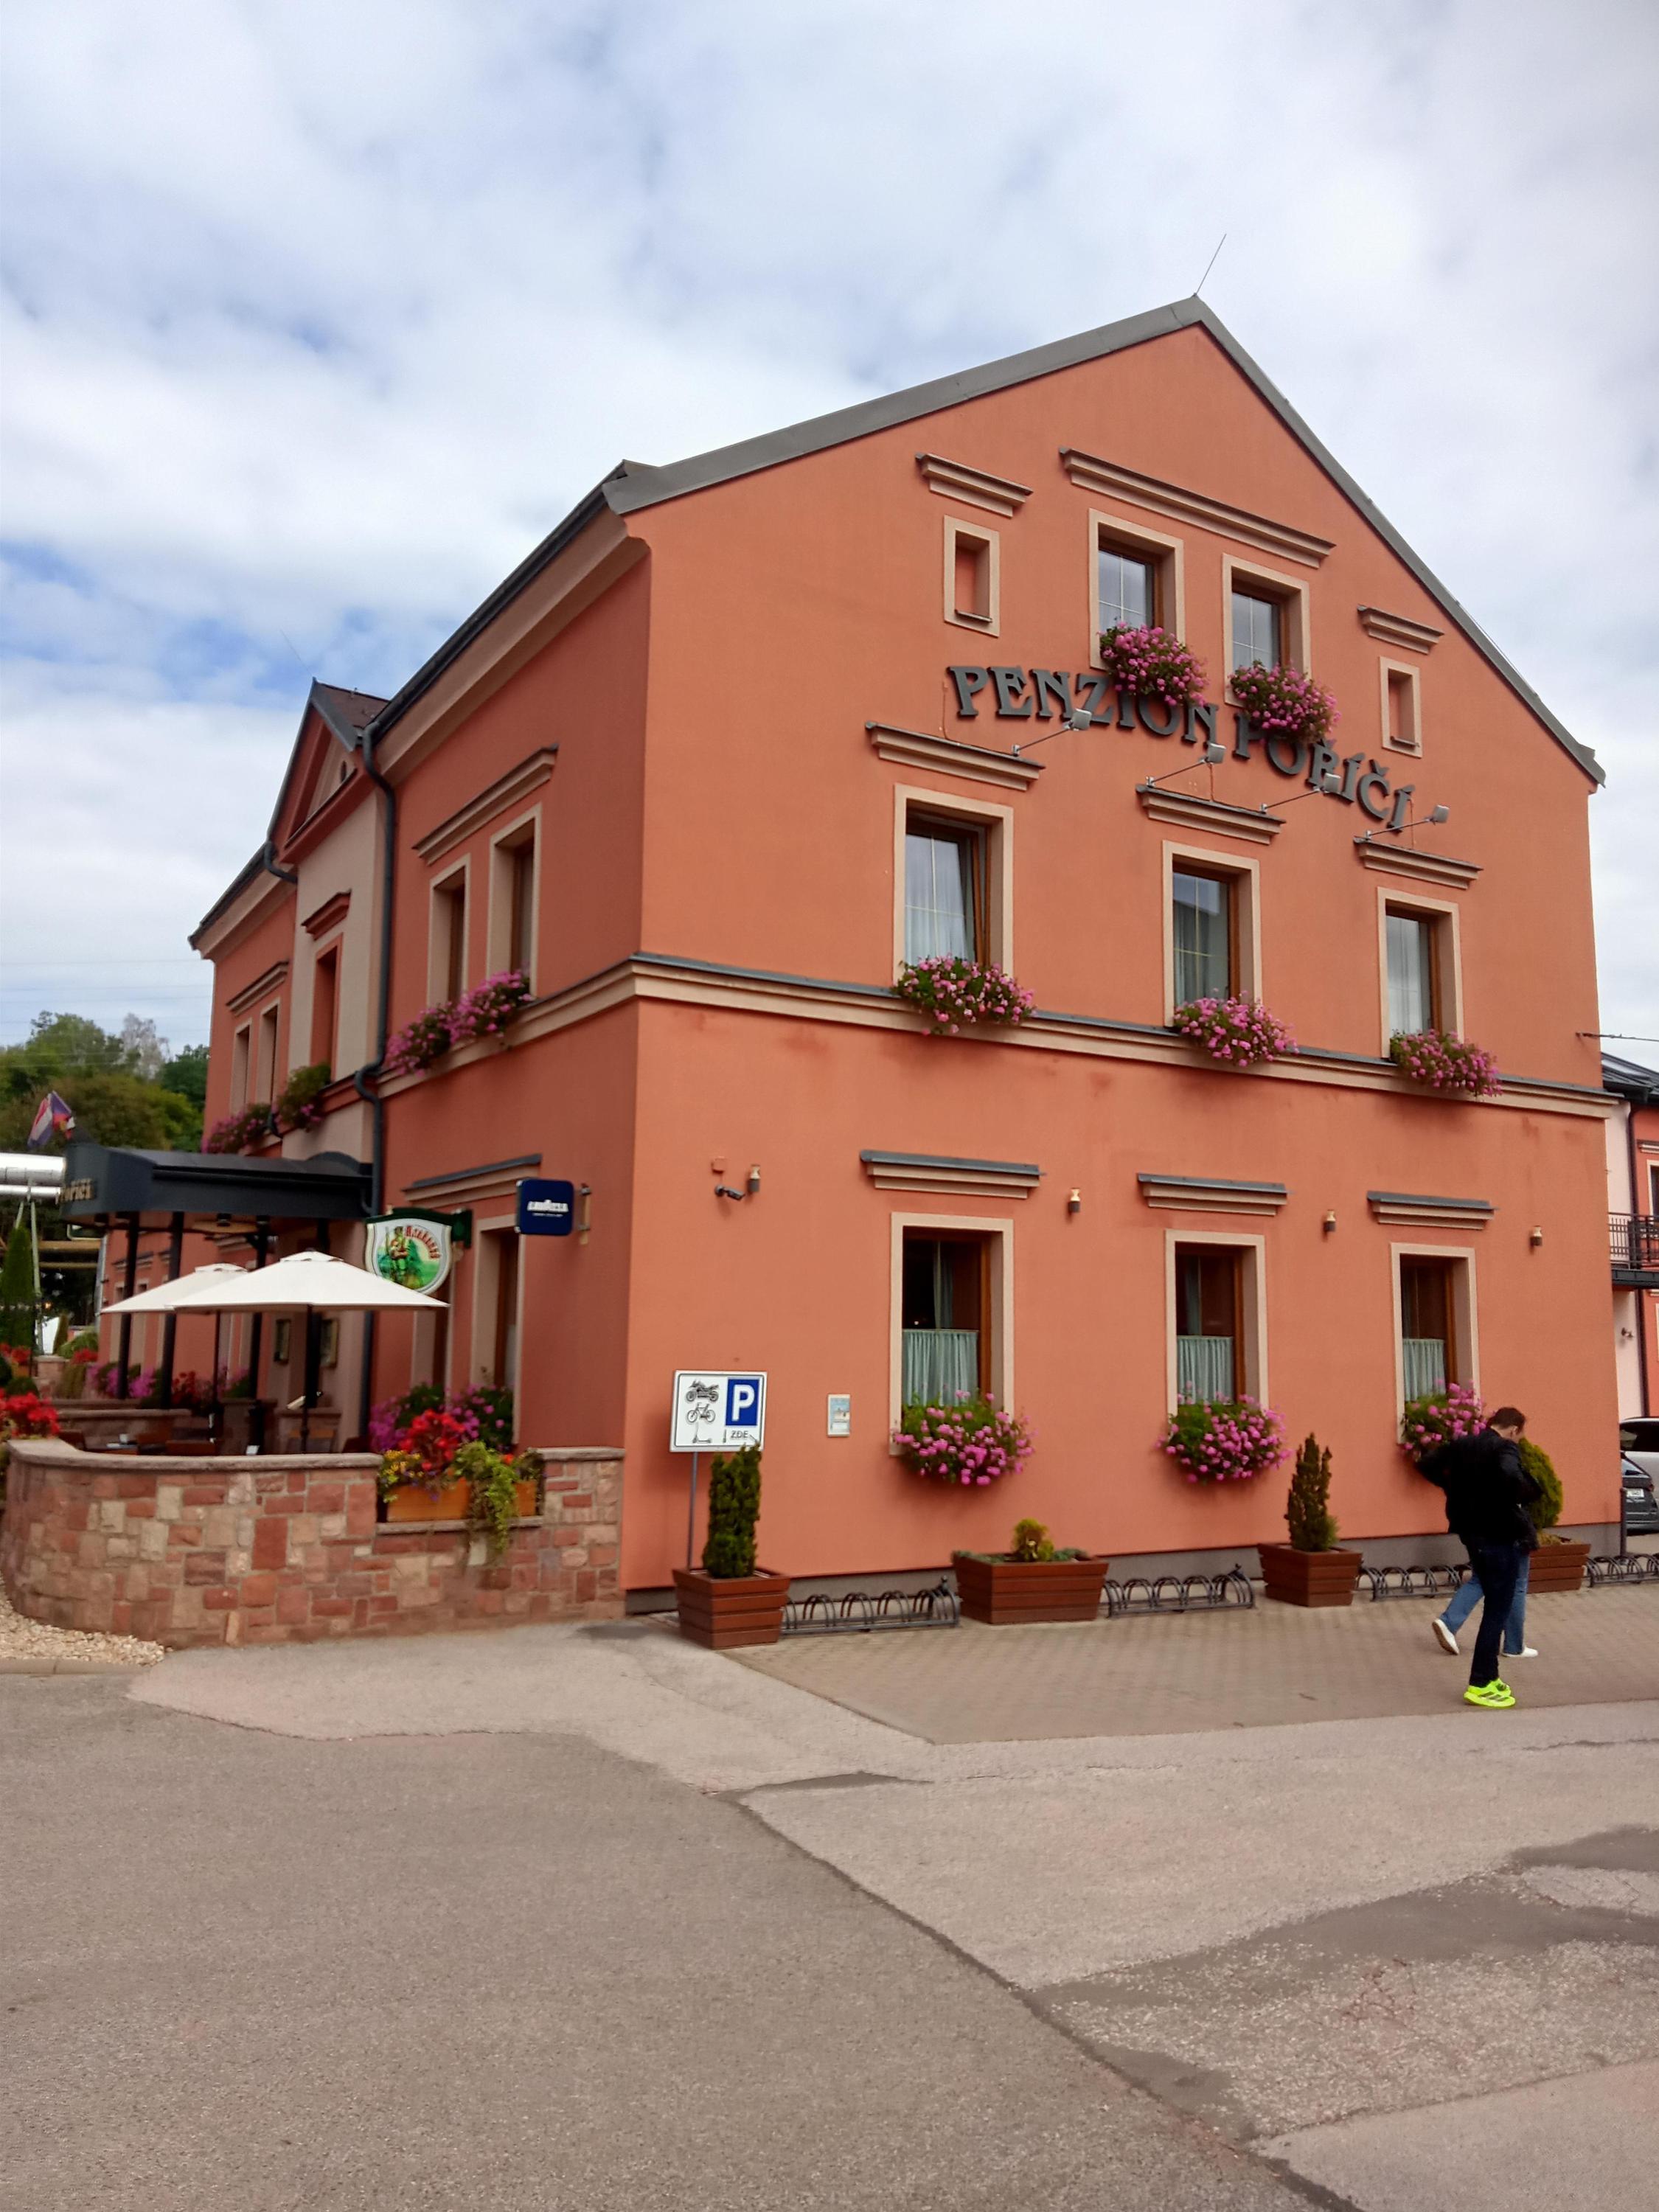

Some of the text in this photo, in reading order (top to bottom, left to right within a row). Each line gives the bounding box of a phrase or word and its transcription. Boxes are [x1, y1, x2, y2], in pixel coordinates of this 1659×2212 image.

[947, 665, 1220, 749] PENZION
[731, 1384, 755, 1422] P
[731, 1430, 748, 1439] ZDE
